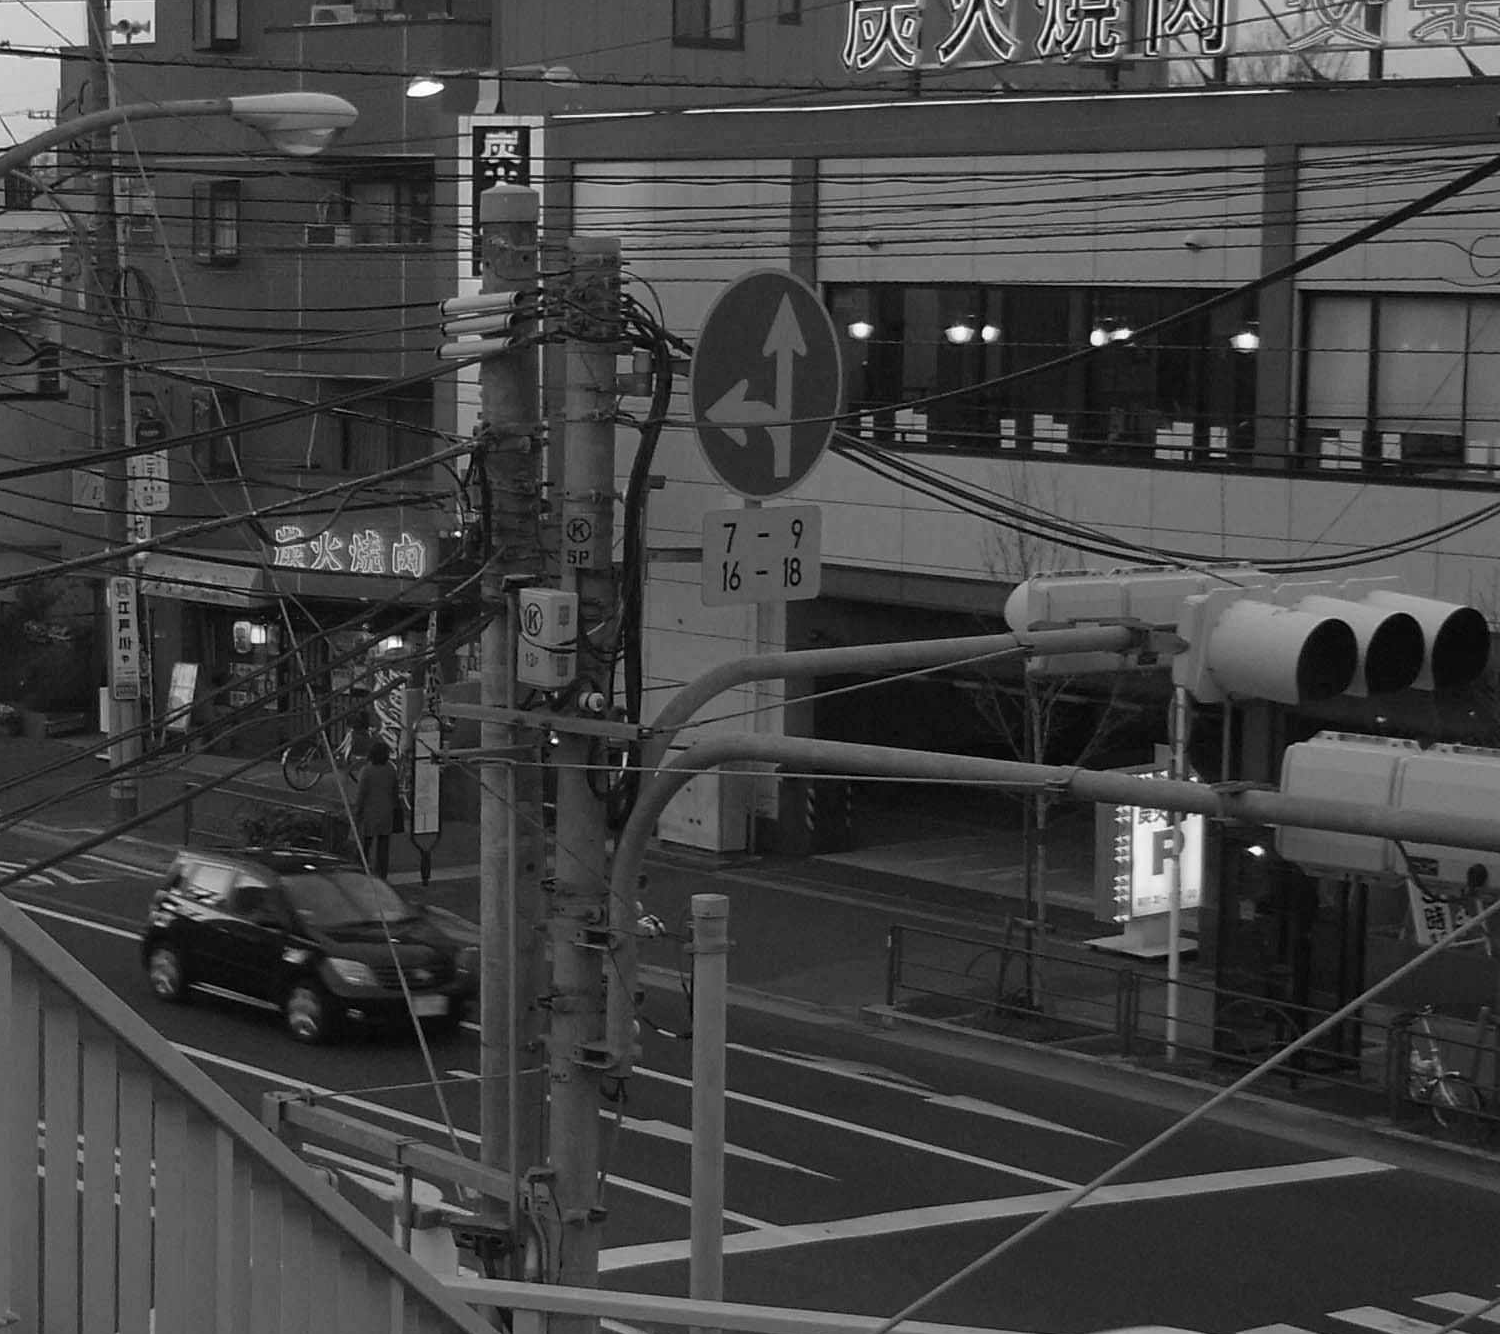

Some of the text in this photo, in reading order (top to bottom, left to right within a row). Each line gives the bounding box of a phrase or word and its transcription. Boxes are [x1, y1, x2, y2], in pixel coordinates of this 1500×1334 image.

[273, 526, 426, 578] 炭火焼肉
[723, 523, 737, 554] 7
[791, 519, 803, 549] 9
[722, 561, 741, 592] 16
[783, 557, 802, 588] 18
[1153, 829, 1185, 875] P
